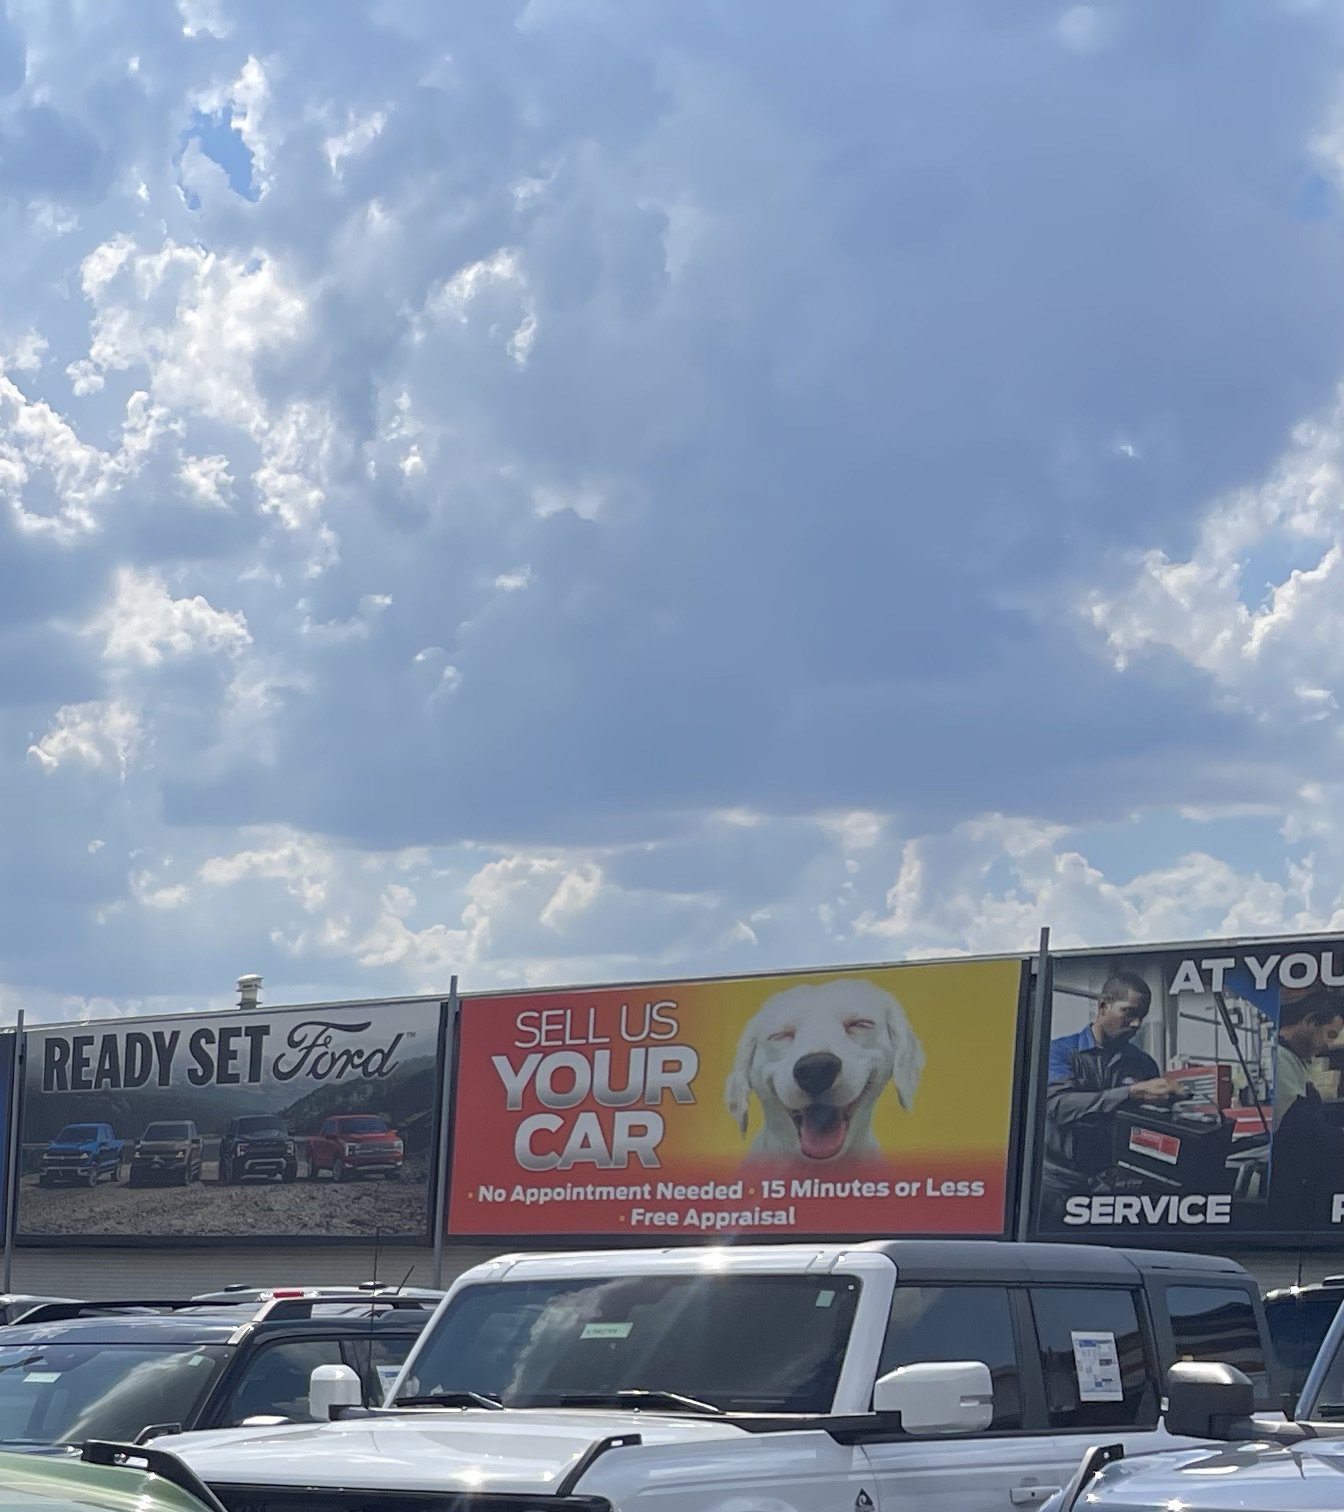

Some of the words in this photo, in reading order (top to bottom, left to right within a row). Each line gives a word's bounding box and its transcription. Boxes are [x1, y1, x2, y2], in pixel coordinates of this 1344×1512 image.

[1169, 958, 1236, 995] AT
[514, 1007, 610, 1048] SELL
[620, 1001, 679, 1042] US
[42, 1028, 182, 1092] READY
[187, 1024, 271, 1086] SET
[272, 1020, 406, 1081] Ford
[491, 1045, 700, 1111] YOUR
[514, 1110, 664, 1171] CAR
[477, 1184, 507, 1202] No
[510, 1182, 651, 1205] Appointment
[656, 1180, 743, 1200] Needed
[761, 1180, 785, 1199] 15
[790, 1178, 889, 1198] Minutes
[894, 1181, 920, 1197] or
[926, 1177, 985, 1198] Less
[1063, 1194, 1232, 1225] SERVICE
[630, 1207, 679, 1227] Free
[683, 1206, 796, 1230] Appraisal
